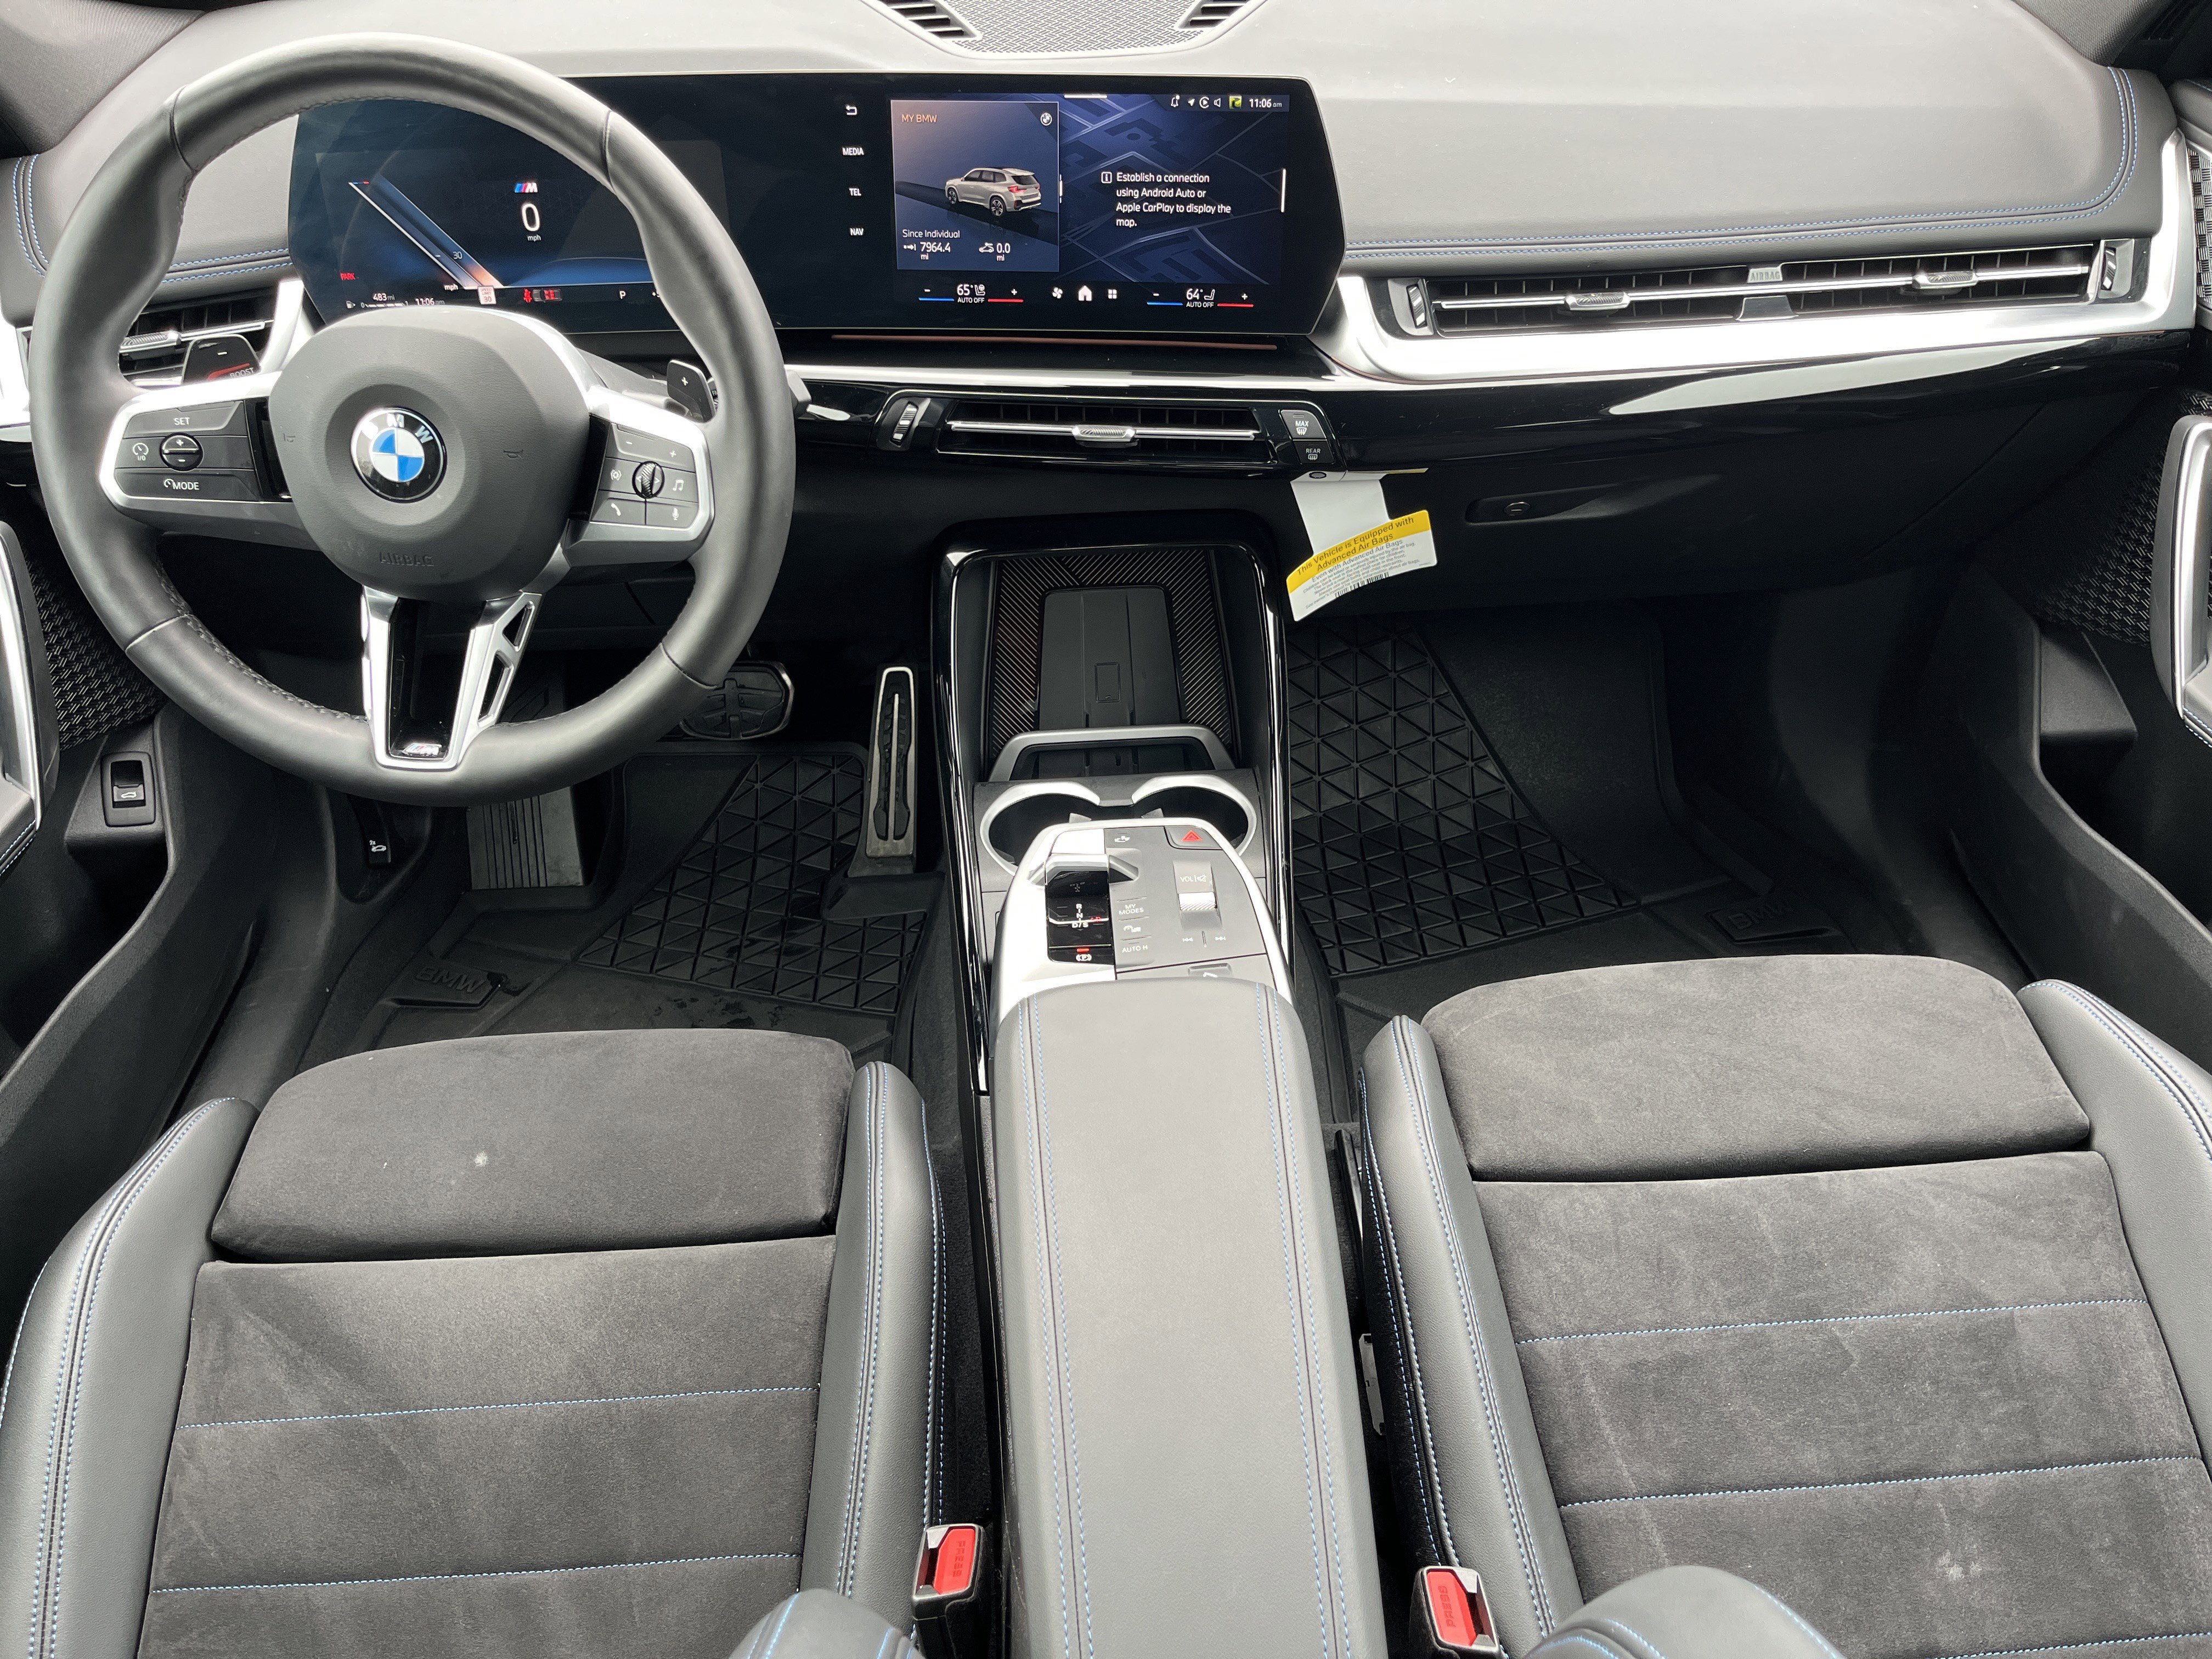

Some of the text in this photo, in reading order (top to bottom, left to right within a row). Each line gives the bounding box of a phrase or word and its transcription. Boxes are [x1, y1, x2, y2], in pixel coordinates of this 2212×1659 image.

[1249, 98, 1272, 108] 11:06
[901, 114, 938, 123] MY BMW
[842, 147, 864, 156] MEDIA
[1116, 172, 1210, 183] Establish a connection
[849, 188, 861, 196] TEL
[1116, 188, 1206, 199] using Android Auto or
[1116, 203, 1231, 215] Apple CarPlay to display the
[521, 202, 540, 232] 0
[1116, 219, 1137, 228] map.
[850, 228, 864, 236] NAV
[902, 229, 960, 239] Since Individual
[920, 241, 951, 253] 7964.4
[996, 242, 1011, 253] 0.0
[453, 251, 463, 259] 30
[340, 272, 356, 280] PARK
[1750, 271, 1780, 281] AIRBAG
[373, 292, 387, 301] 483
[619, 291, 626, 299] P
[415, 297, 435, 306] 11:06
[230, 367, 254, 379] BOOST
[174, 417, 190, 425] SET
[172, 482, 199, 490] MODE
[1297, 562, 1312, 575] This
[1313, 546, 1344, 563] Vehicle
[1353, 522, 1393, 545] Equipped
[1395, 517, 1414, 528] with
[1317, 534, 1393, 572] Advanced Air Bags
[379, 552, 435, 567] AIRBAG
[1312, 571, 1327, 583] Even
[1328, 563, 1341, 573] with
[1342, 549, 1374, 567] Advanced
[1385, 539, 1403, 549] Bags
[1119, 907, 1144, 915] MODES
[415, 966, 486, 993] BMW
[952, 1541, 966, 1577] PRESS
[1438, 1585, 1456, 1628] PRESS
